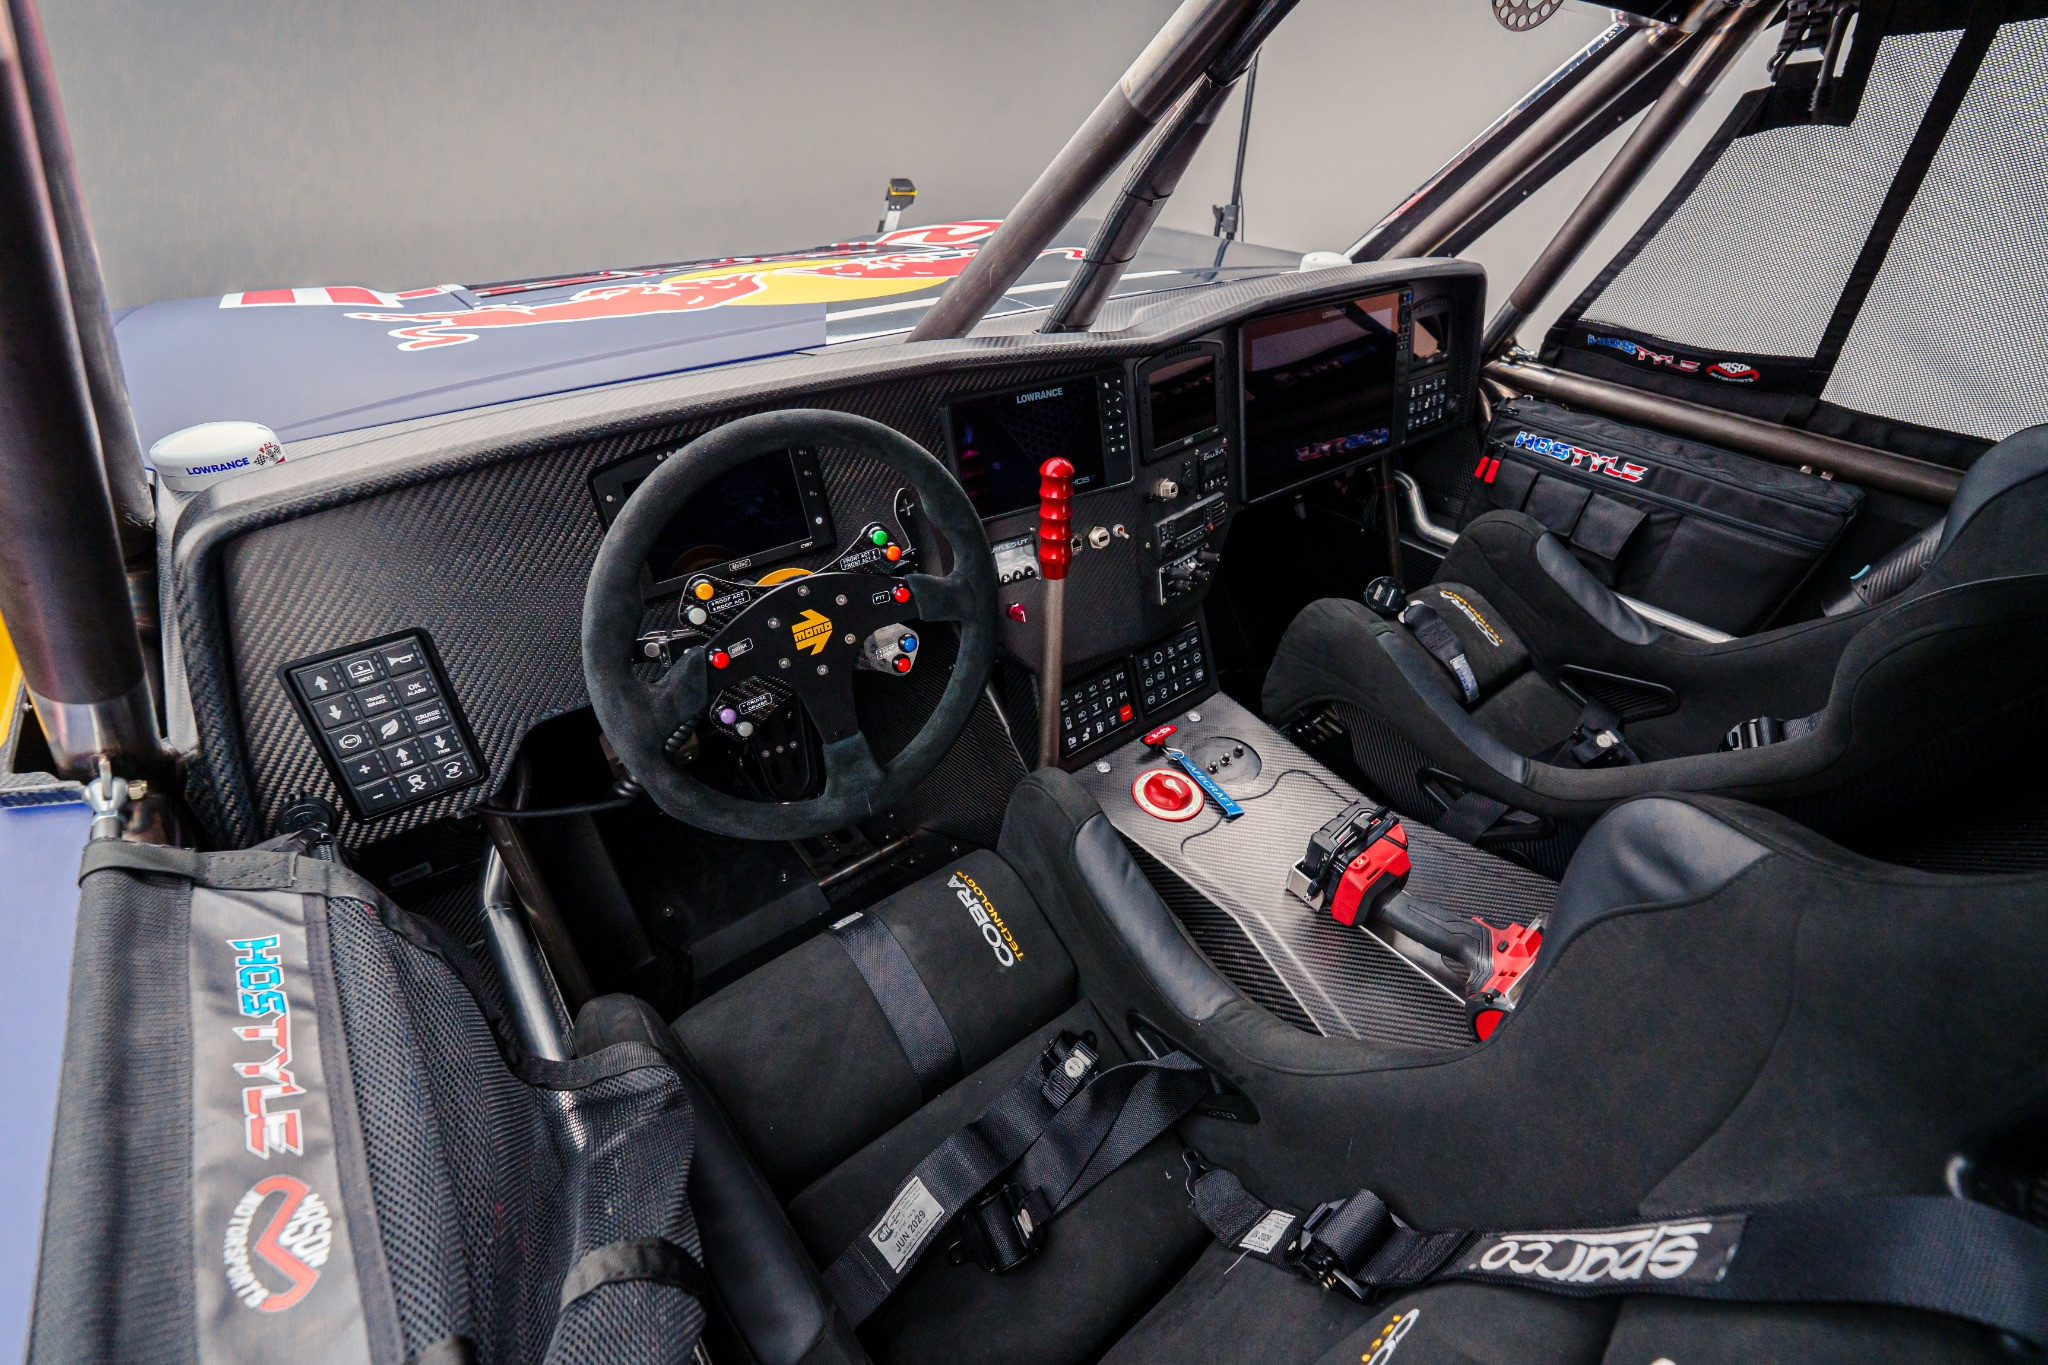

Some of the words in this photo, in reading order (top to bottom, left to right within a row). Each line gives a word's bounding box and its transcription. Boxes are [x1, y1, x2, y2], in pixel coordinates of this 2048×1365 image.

[1588, 334, 1700, 372] HOSTYLE
[1718, 362, 1751, 374] MASON
[1016, 387, 1063, 404] LOWRANCE
[1514, 431, 1648, 482] HOSTYLE
[186, 457, 250, 475] LOWRANCE
[1116, 672, 1125, 681] P2
[407, 687, 427, 696] ALARM
[408, 682, 421, 691] OK
[365, 694, 386, 702] TRANS
[1106, 696, 1113, 708] P
[1119, 691, 1128, 700] P1
[415, 709, 440, 721] CRUISE
[417, 715, 442, 725] CONTROL
[947, 874, 1014, 967] COBRA
[226, 933, 306, 1160] HOSTYLE
[278, 1192, 333, 1270] MASON
[895, 1231, 910, 1252] JUN
[907, 1210, 926, 1233] 2029
[223, 1188, 269, 1309] MOTORSPORTS
[1479, 1223, 1712, 1282] sparco
